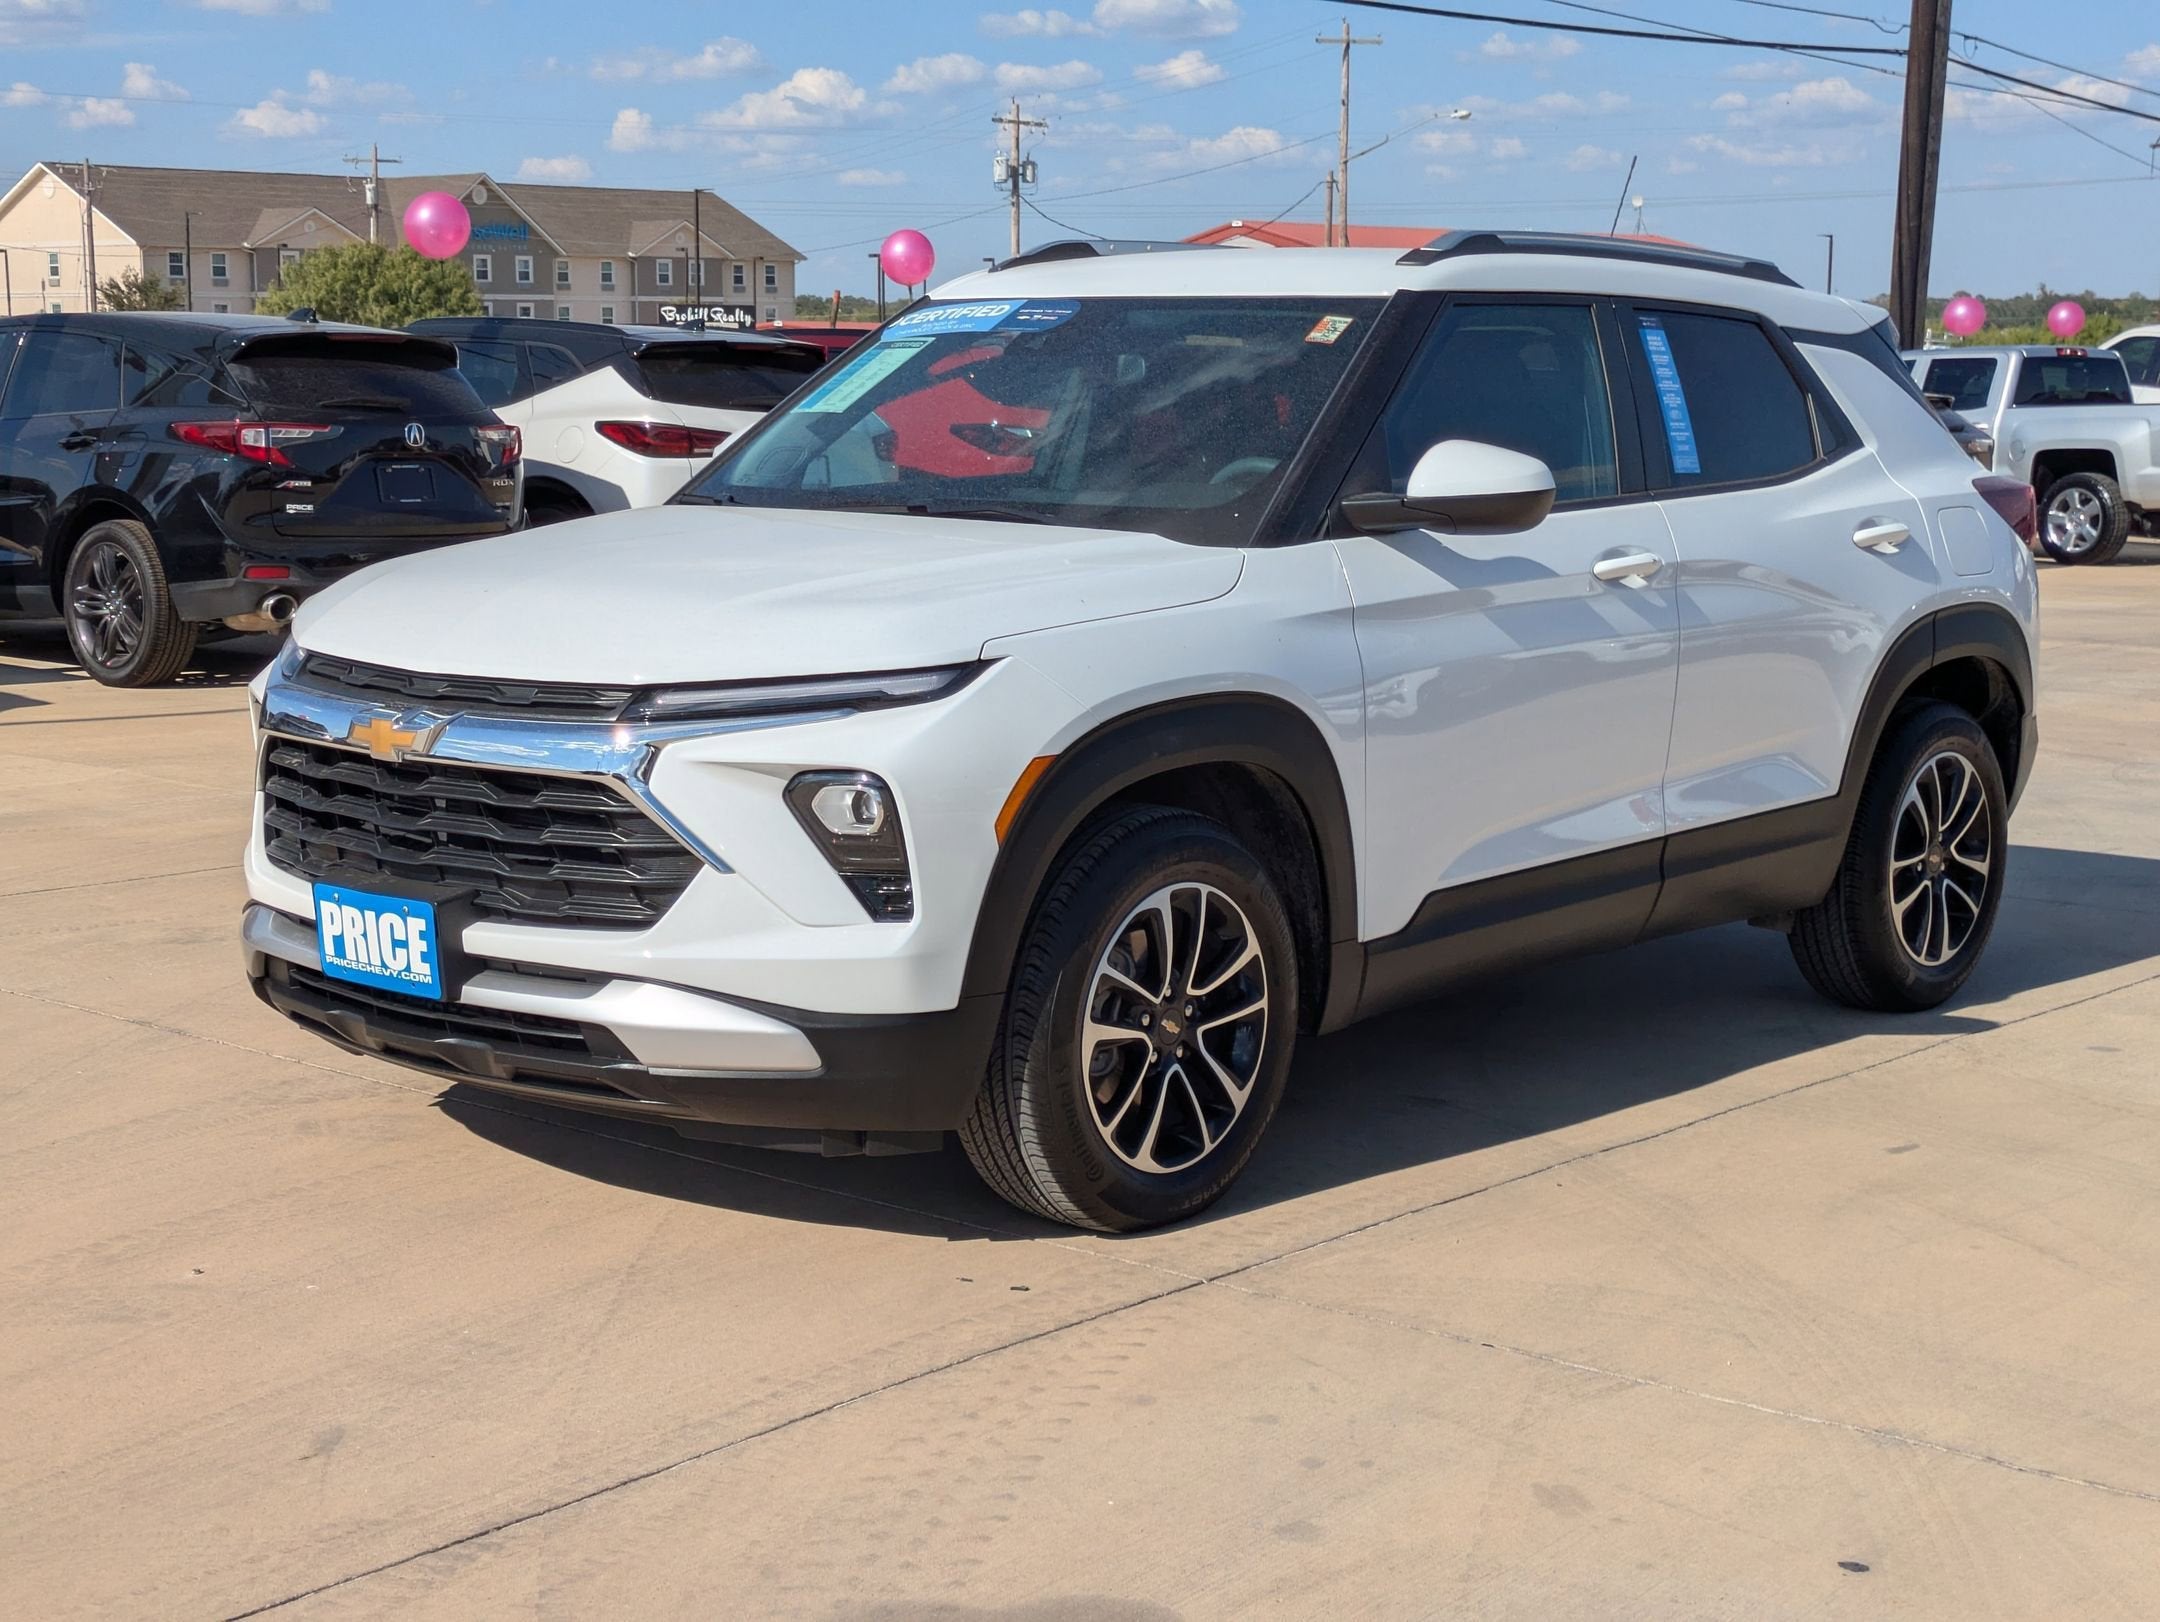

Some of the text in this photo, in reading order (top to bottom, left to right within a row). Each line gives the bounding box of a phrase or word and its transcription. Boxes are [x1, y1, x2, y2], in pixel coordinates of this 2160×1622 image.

[660, 305, 709, 322] Brohill
[710, 307, 755, 328] Realty
[899, 304, 1011, 326] CERTIFIED
[319, 899, 431, 975] PRICE
[325, 955, 433, 984] PRICECHEVY.COM
